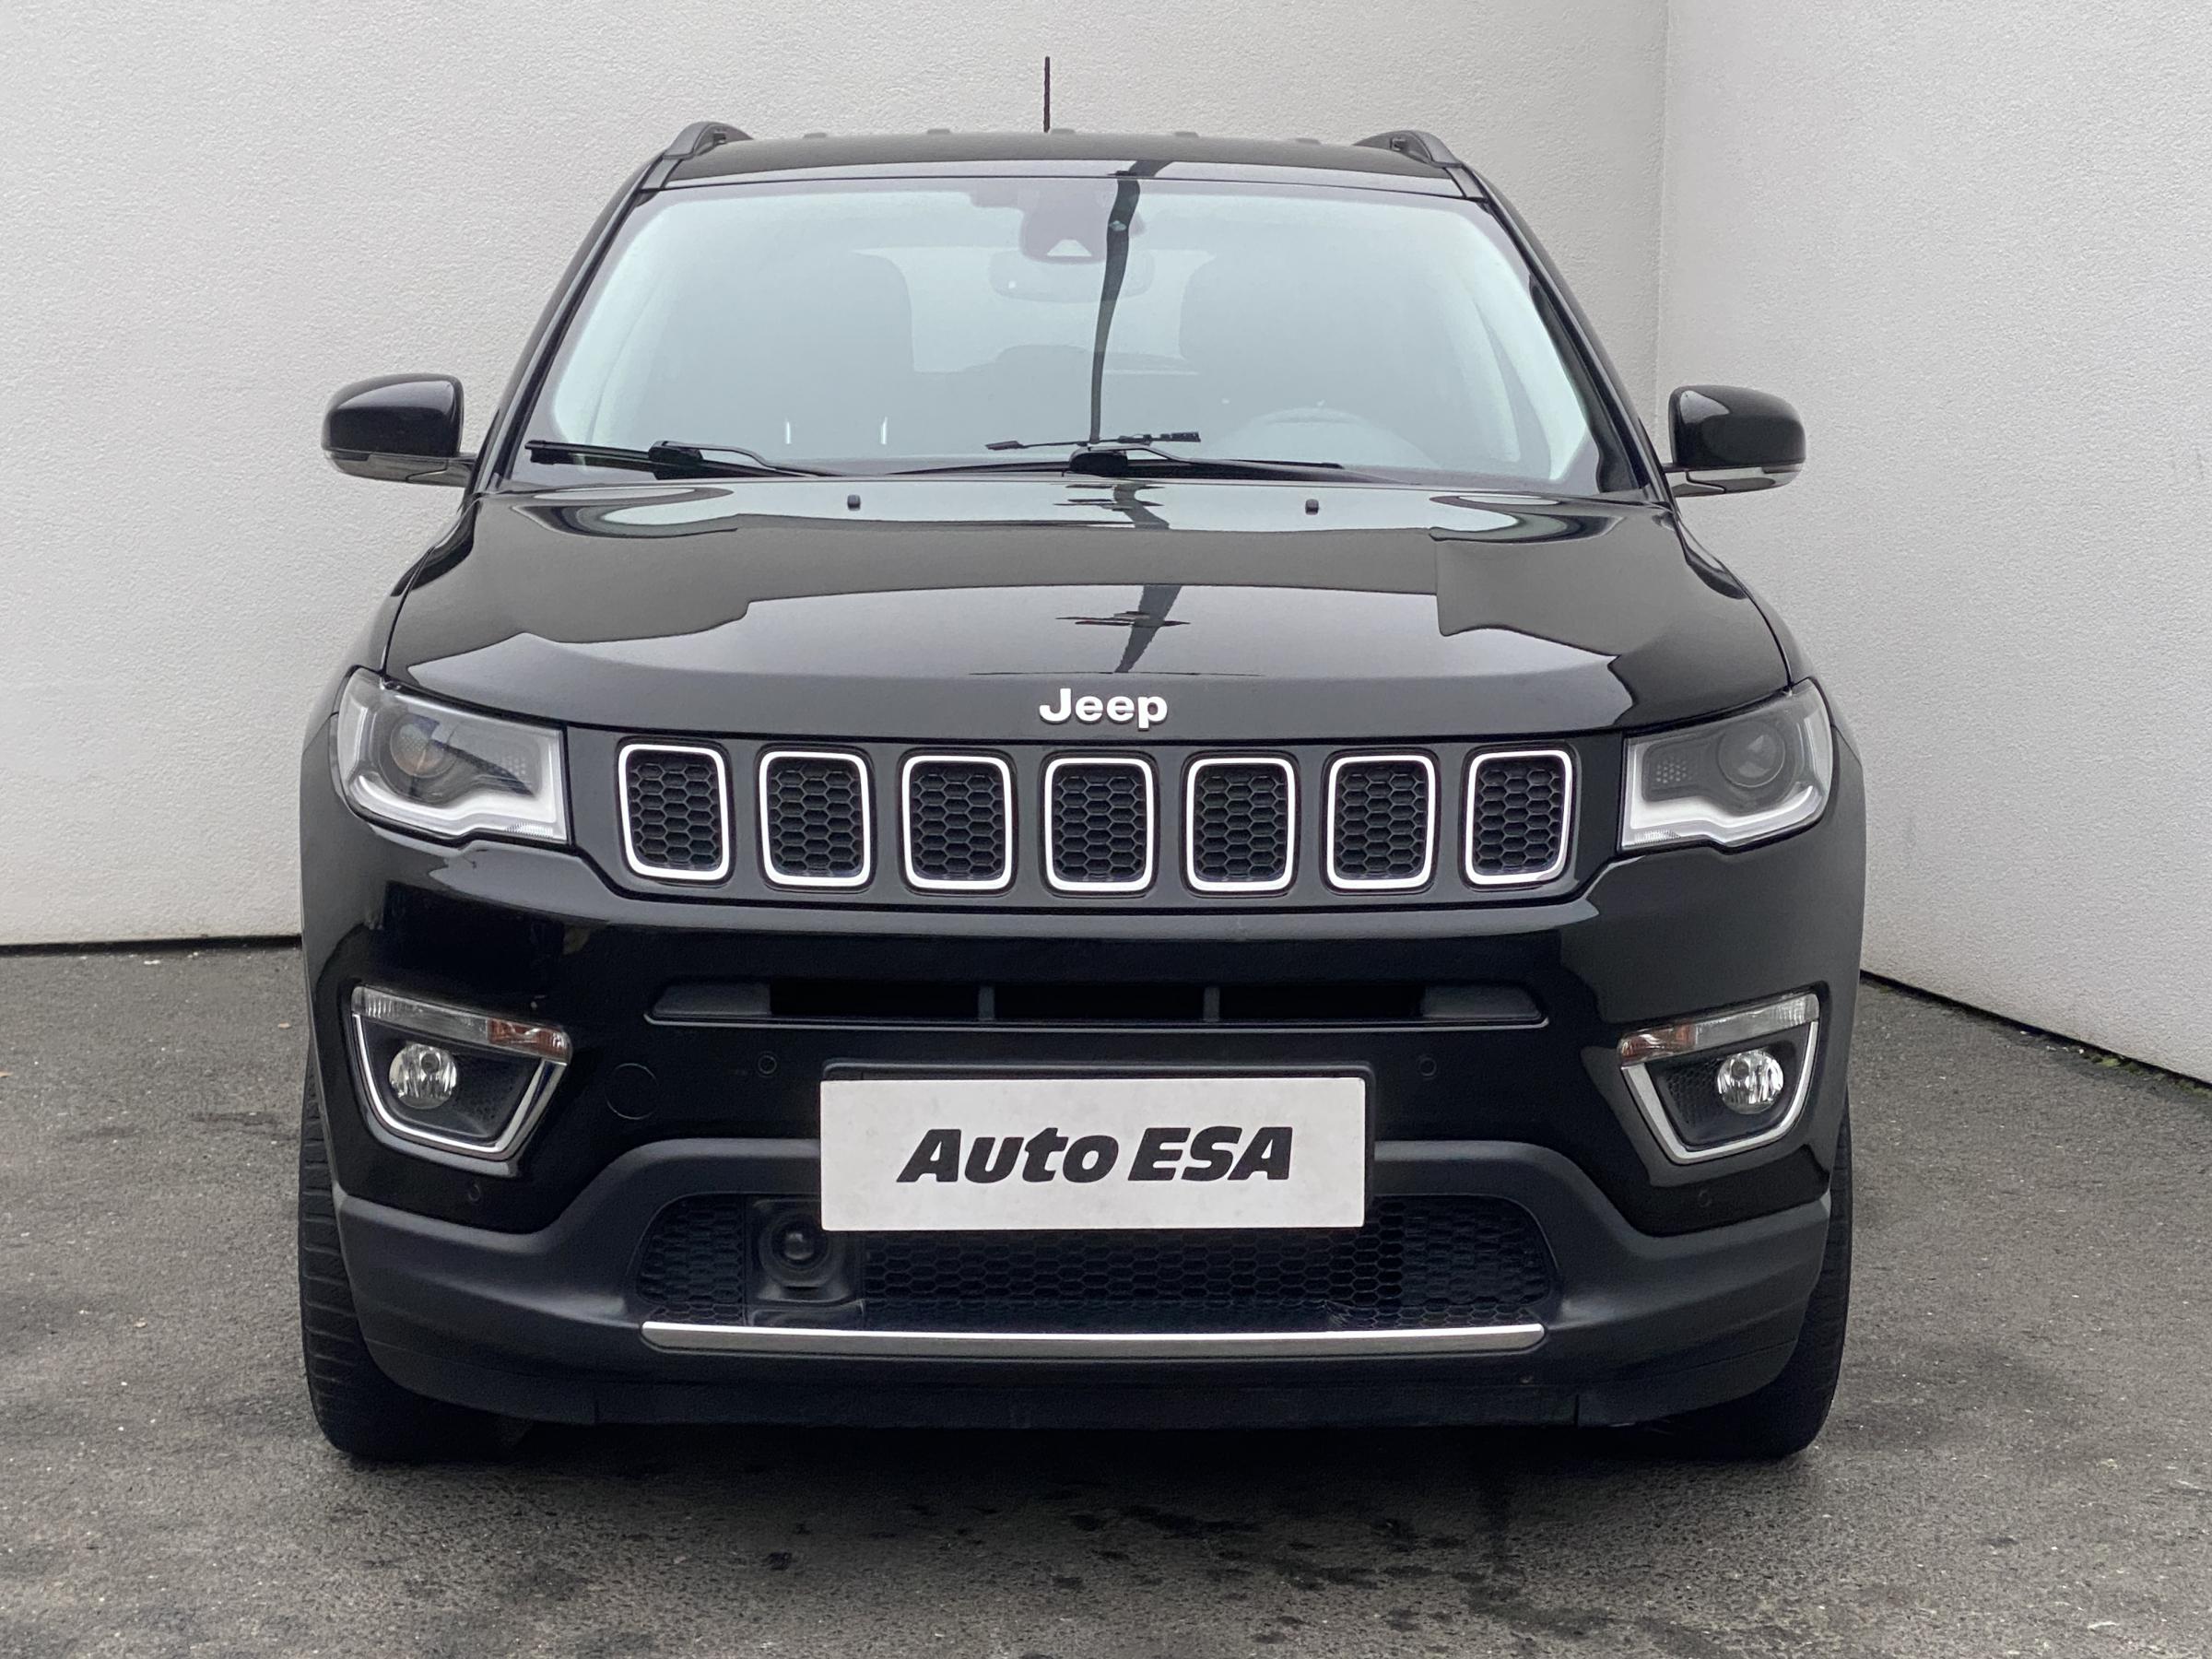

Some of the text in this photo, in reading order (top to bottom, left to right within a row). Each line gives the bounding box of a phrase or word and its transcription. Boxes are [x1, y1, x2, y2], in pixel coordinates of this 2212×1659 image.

[1039, 687, 1170, 730] Jeep
[896, 1125, 1293, 1184] Auto ESA
